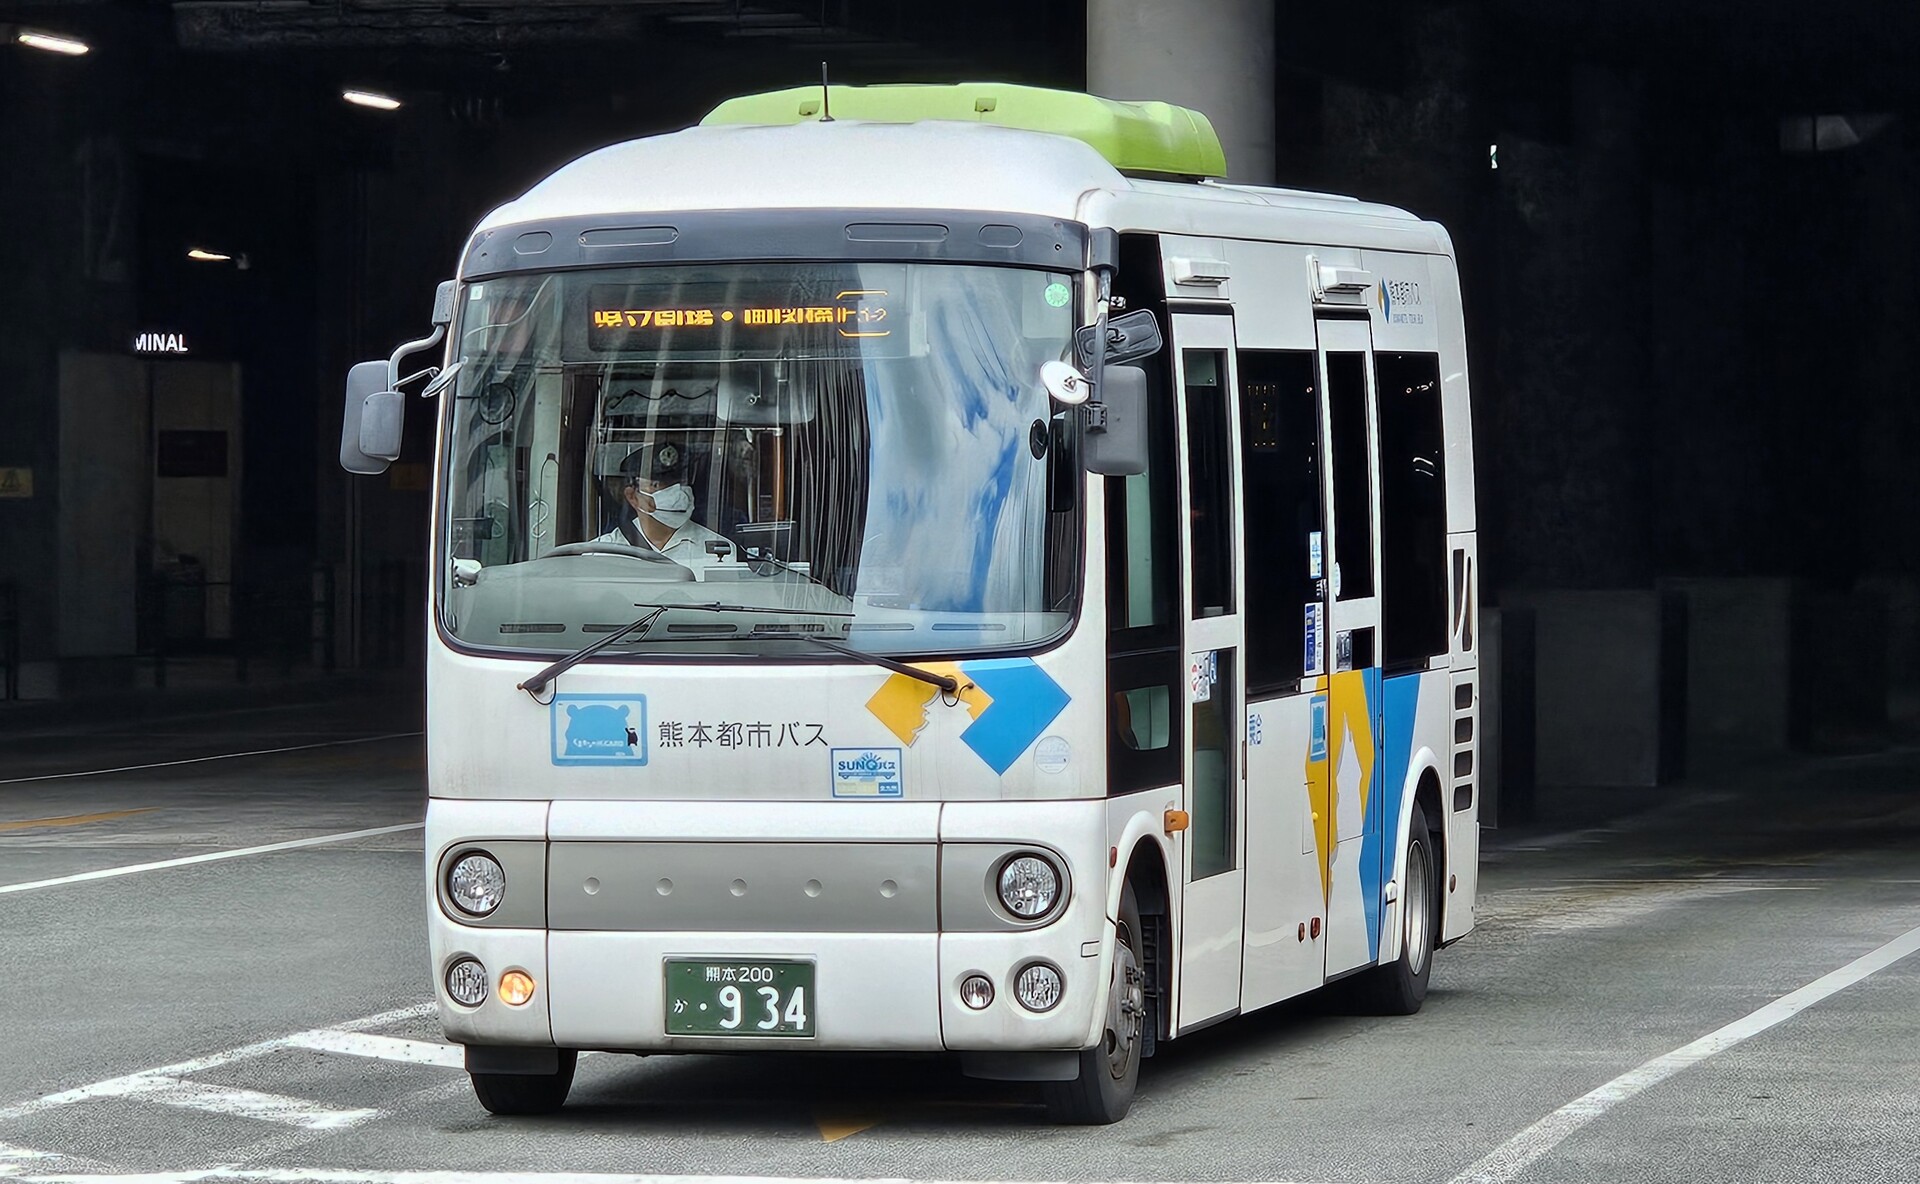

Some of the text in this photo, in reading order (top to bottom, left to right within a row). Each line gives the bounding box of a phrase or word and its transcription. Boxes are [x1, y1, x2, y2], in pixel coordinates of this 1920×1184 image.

[658, 720, 829, 750] 熊本都市バス
